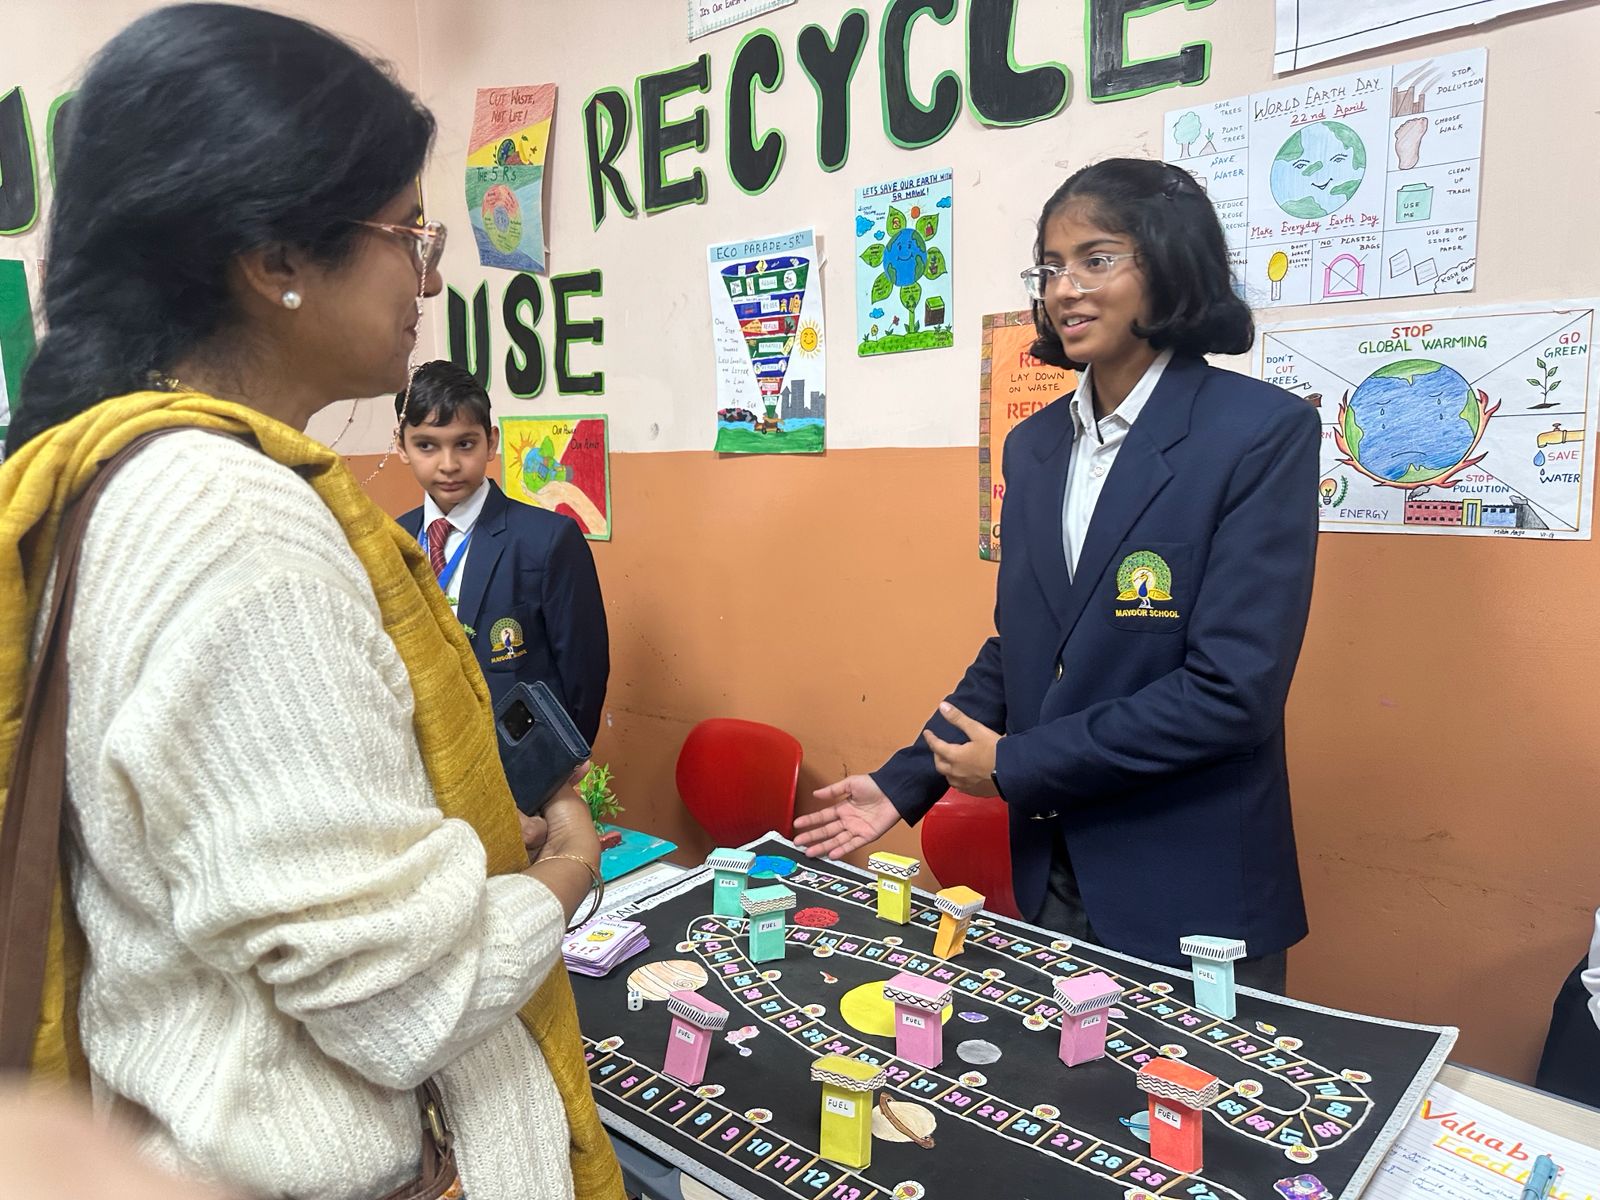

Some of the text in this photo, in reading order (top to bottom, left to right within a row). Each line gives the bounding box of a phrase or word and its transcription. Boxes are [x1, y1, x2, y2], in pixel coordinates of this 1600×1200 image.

[1451, 66, 1472, 77] STOP
[1437, 77, 1484, 95] POLLUTION
[1254, 78, 1380, 119] WORLD EARTH DAY
[1214, 101, 1230, 110] SAVE
[1221, 107, 1242, 116] TREES
[1334, 101, 1366, 118] April
[583, 0, 1213, 232] RECYCLE
[1434, 114, 1461, 126] CHOOSE
[1222, 126, 1243, 135] PLANT
[1439, 124, 1463, 134] WALK
[1222, 134, 1246, 143] TREES
[1210, 155, 1235, 167] SAVE
[490, 167, 498, 181] 5
[1214, 169, 1245, 181] WATER
[1448, 167, 1471, 175] CLEAN
[863, 186, 878, 196] LETS
[880, 182, 898, 195] SAVE
[900, 179, 914, 190] OUR
[916, 175, 938, 187] EARTH
[1216, 201, 1244, 210] REDUCE
[1403, 201, 1421, 209] USE
[1251, 213, 1379, 237] Make Everyday Earth Day
[1340, 235, 1377, 245] PLASTIC
[717, 247, 737, 259] ECO
[1390, 324, 1433, 340] STOP
[1559, 332, 1581, 345] GO
[1358, 335, 1488, 355] GLOBAL WARMING
[1544, 344, 1588, 359] GREEN
[1266, 354, 1294, 364] DON'T
[1275, 365, 1296, 375] CUT
[1011, 371, 1065, 383] LAY DOWN
[1264, 375, 1299, 386] TREES
[1028, 383, 1060, 392] WASTE
[1547, 451, 1580, 462] SAVE
[1465, 474, 1494, 483] STOP
[1540, 472, 1582, 484] WATER
[1452, 485, 1510, 495] POLLUTION
[1339, 508, 1389, 521] ENERGY
[1115, 609, 1180, 618] MAYOOR SCHOOL
[830, 883, 848, 892] 90
[883, 882, 898, 891] FUEL
[852, 891, 870, 900] 89
[701, 922, 720, 932] 44
[762, 922, 777, 931] FUEL
[793, 931, 810, 941] 48
[817, 936, 838, 947] 49
[839, 941, 859, 952] 50
[866, 947, 883, 958] 51
[888, 952, 908, 964] 52
[907, 959, 930, 972] 53
[933, 968, 955, 980] 54
[1199, 970, 1215, 980] FUEL
[959, 978, 981, 990] 55
[743, 988, 763, 1000] 38
[982, 987, 1004, 999] 56
[1007, 994, 1031, 1006] 57
[760, 1000, 782, 1013] 37
[1033, 1004, 1058, 1016] 58
[779, 1014, 802, 1029] 36
[905, 1016, 923, 1027] FUEL
[1083, 1017, 1099, 1026] FUEL
[1178, 1013, 1202, 1026] 75
[678, 1029, 692, 1039] FUEL
[802, 1028, 828, 1043] 35
[824, 1040, 850, 1055] 34
[1107, 1039, 1132, 1052] 61
[1230, 1040, 1257, 1054] 73
[1132, 1053, 1151, 1066] 6
[1258, 1053, 1287, 1067] 72
[600, 1064, 617, 1076] 4
[885, 1066, 910, 1082] 32
[1286, 1066, 1314, 1080] 71
[620, 1075, 639, 1089] 5
[910, 1078, 938, 1093] 31
[641, 1087, 660, 1100] 6
[1315, 1082, 1341, 1096] 70
[828, 1099, 849, 1110] FUEL
[943, 1091, 972, 1107] 30
[668, 1100, 687, 1112] 7
[1217, 1099, 1247, 1115] 65
[694, 1112, 713, 1125] 8
[977, 1105, 1009, 1122] 29
[1158, 1108, 1178, 1122] FUEL
[1012, 1119, 1042, 1136] 28
[1245, 1114, 1275, 1132] 66
[721, 1127, 740, 1141] 9
[746, 1138, 773, 1157] 10
[1050, 1133, 1084, 1151] 27
[774, 1154, 801, 1172] 11
[1090, 1150, 1123, 1169] 26
[802, 1168, 831, 1189] 12
[1129, 1167, 1167, 1186] 25
[831, 1184, 861, 1200] 13
